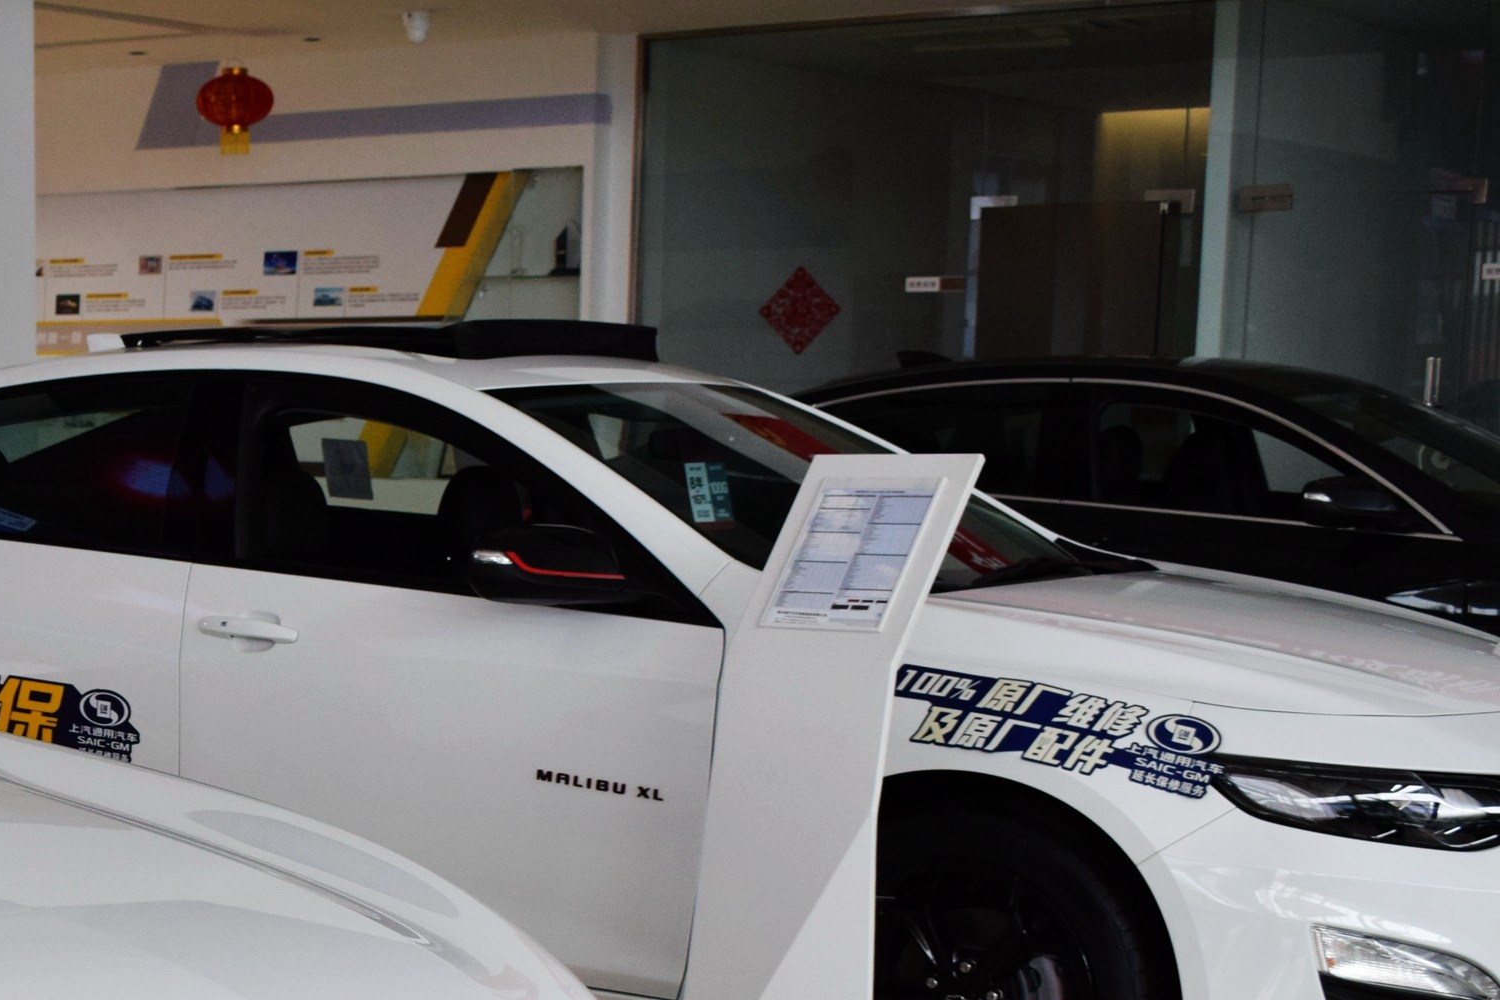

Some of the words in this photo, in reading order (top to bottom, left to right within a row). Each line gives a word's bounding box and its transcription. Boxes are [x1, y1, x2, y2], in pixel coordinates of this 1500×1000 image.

[68, 723, 138, 743] 上汽通用汽车
[77, 735, 131, 752] SAIC-GM
[912, 705, 1114, 774] 及原厂配件
[1125, 743, 1225, 775] 上汽通用汽车
[1134, 757, 1211, 784] SAIC-GM
[536, 769, 627, 795] MALIBU
[636, 786, 665, 802] XL
[1130, 769, 1206, 797] 延长保修服务
